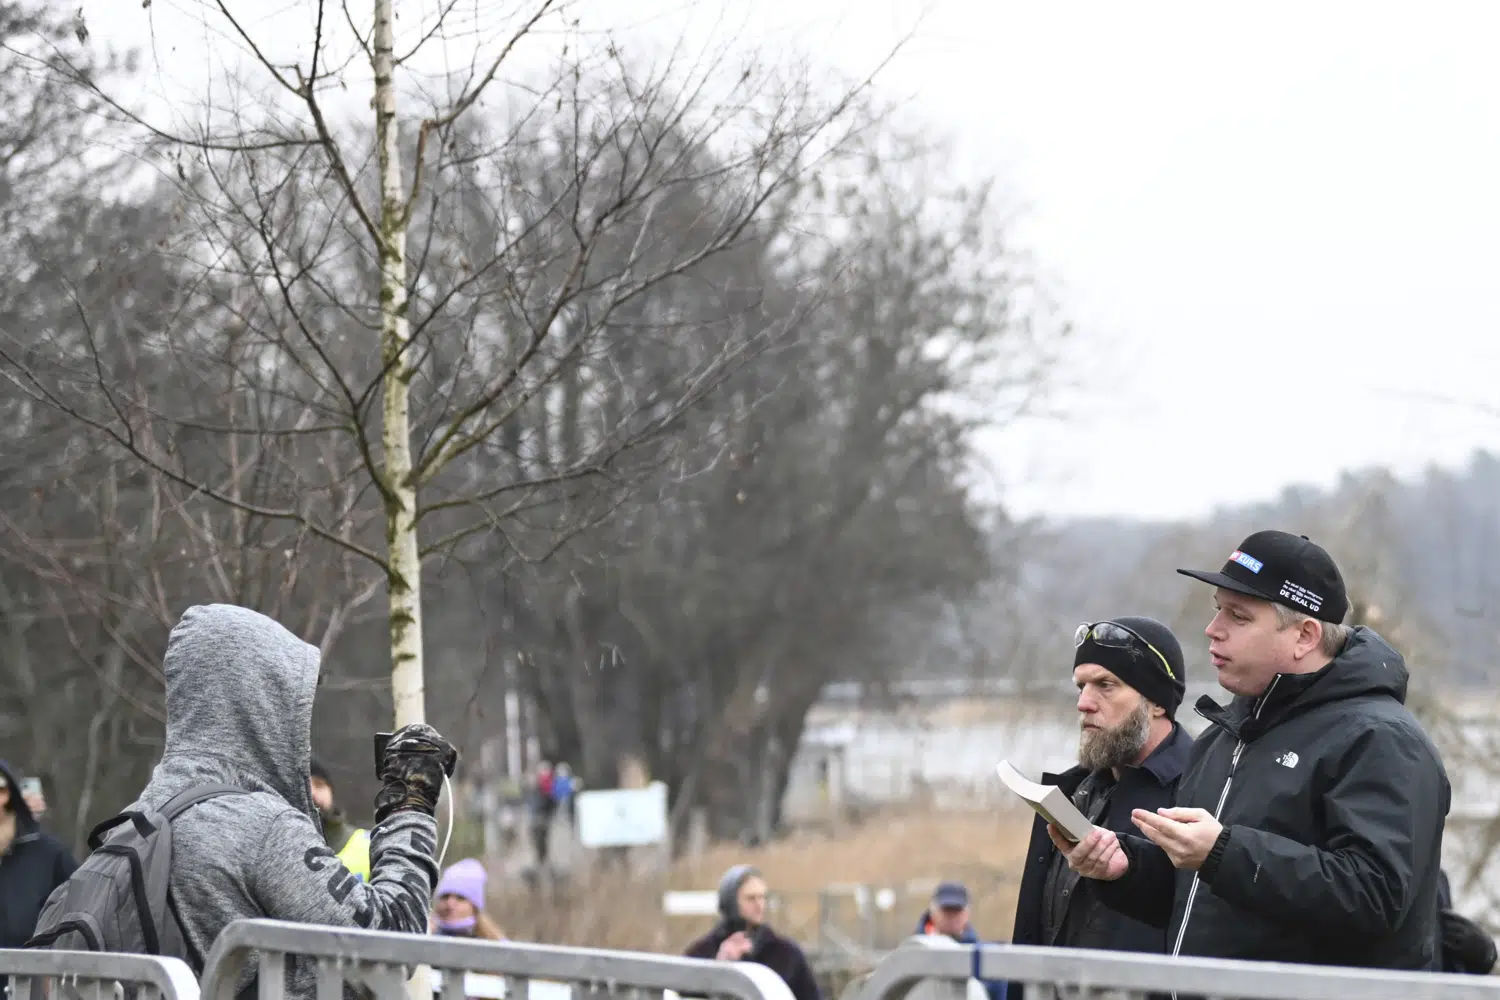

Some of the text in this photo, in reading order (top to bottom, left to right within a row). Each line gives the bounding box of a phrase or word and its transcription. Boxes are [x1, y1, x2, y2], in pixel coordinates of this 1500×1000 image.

[1237, 554, 1261, 571] KURS
[1280, 589, 1290, 598] DE
[1291, 594, 1308, 607] SKAL
[1309, 603, 1320, 612] UD
